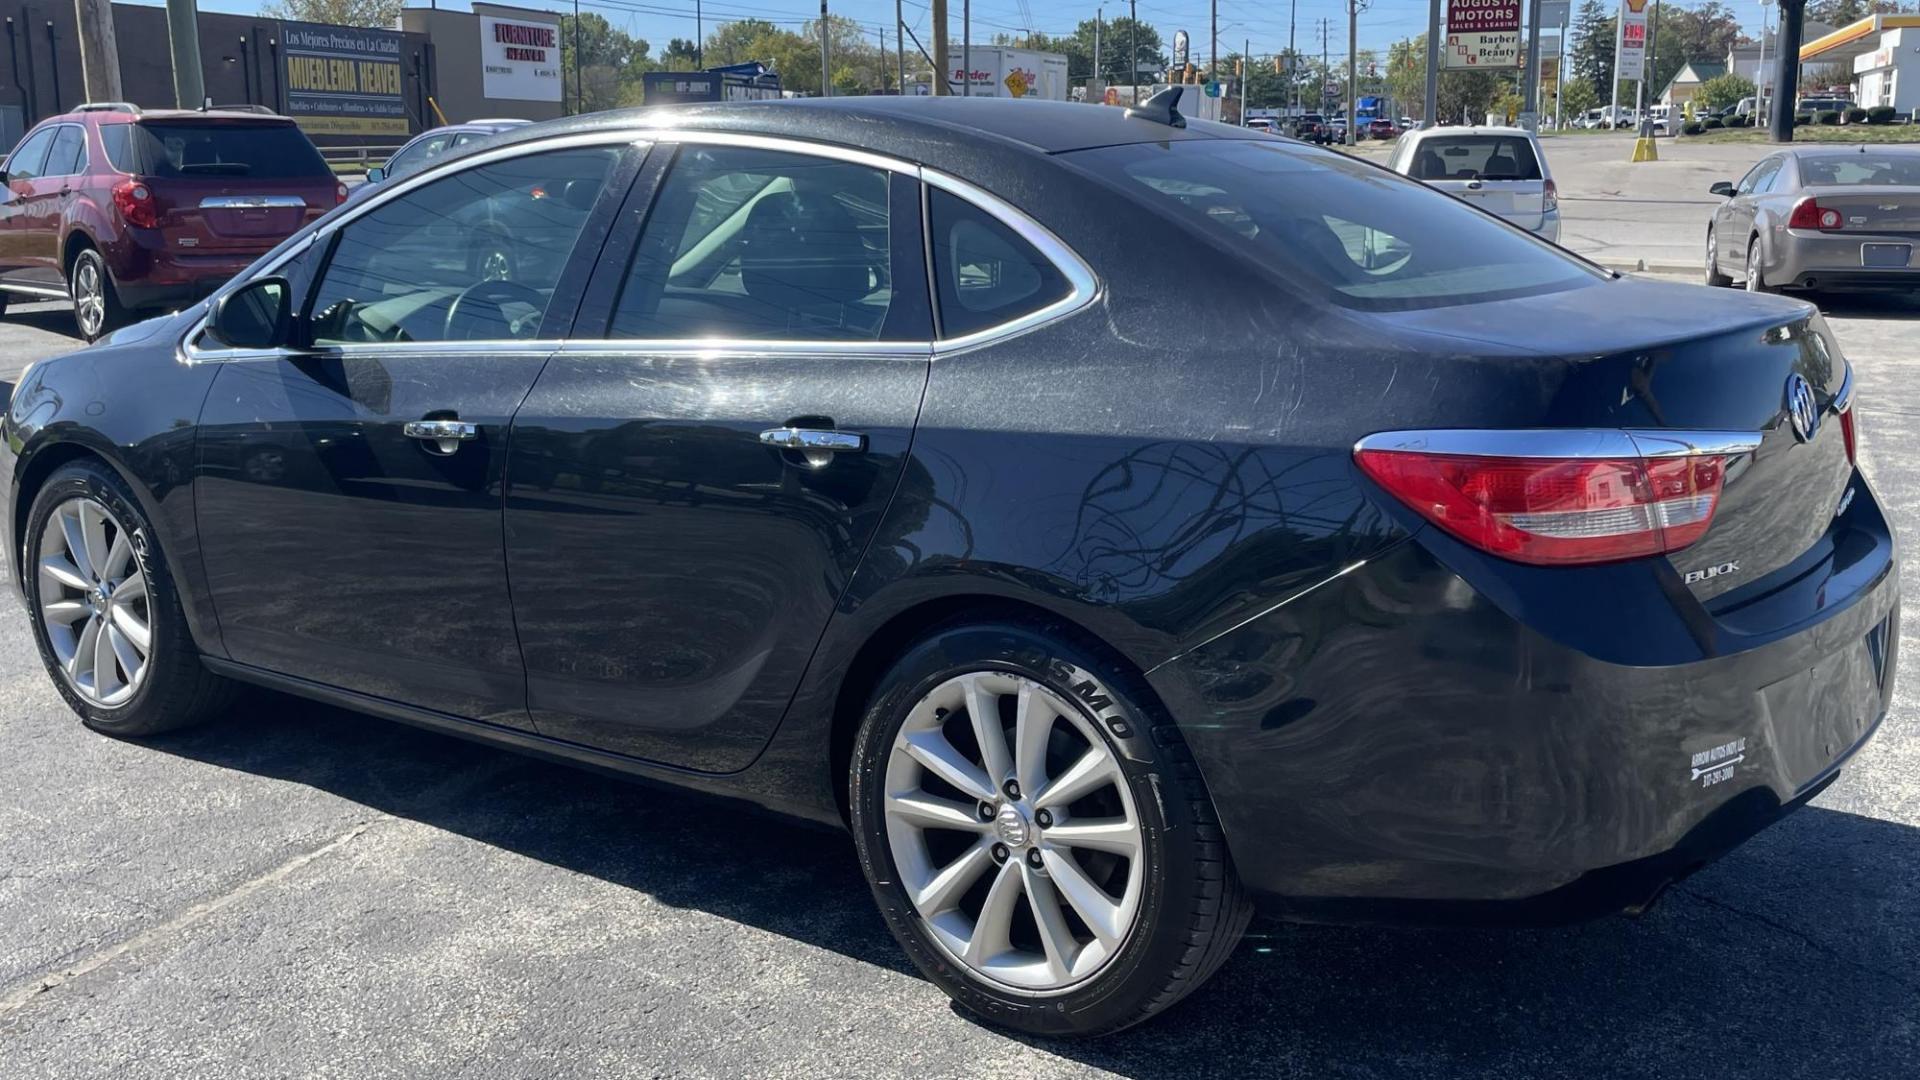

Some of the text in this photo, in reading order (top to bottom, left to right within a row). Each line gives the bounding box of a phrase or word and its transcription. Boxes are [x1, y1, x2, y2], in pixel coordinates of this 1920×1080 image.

[1455, 9, 1513, 20] MOTORS
[286, 30, 399, 53] Los Mejores Precios en La Ciudad
[494, 24, 555, 48] FURNITURE
[1480, 35, 1517, 44] Barber
[1480, 49, 1515, 57] Beauty
[288, 57, 401, 94] MUEBLERIA HEAVEN
[954, 70, 991, 80] Rder
[1685, 560, 1740, 584] BUICK
[1691, 751, 1710, 767] ARROW
[1710, 745, 1725, 760] AUTOS
